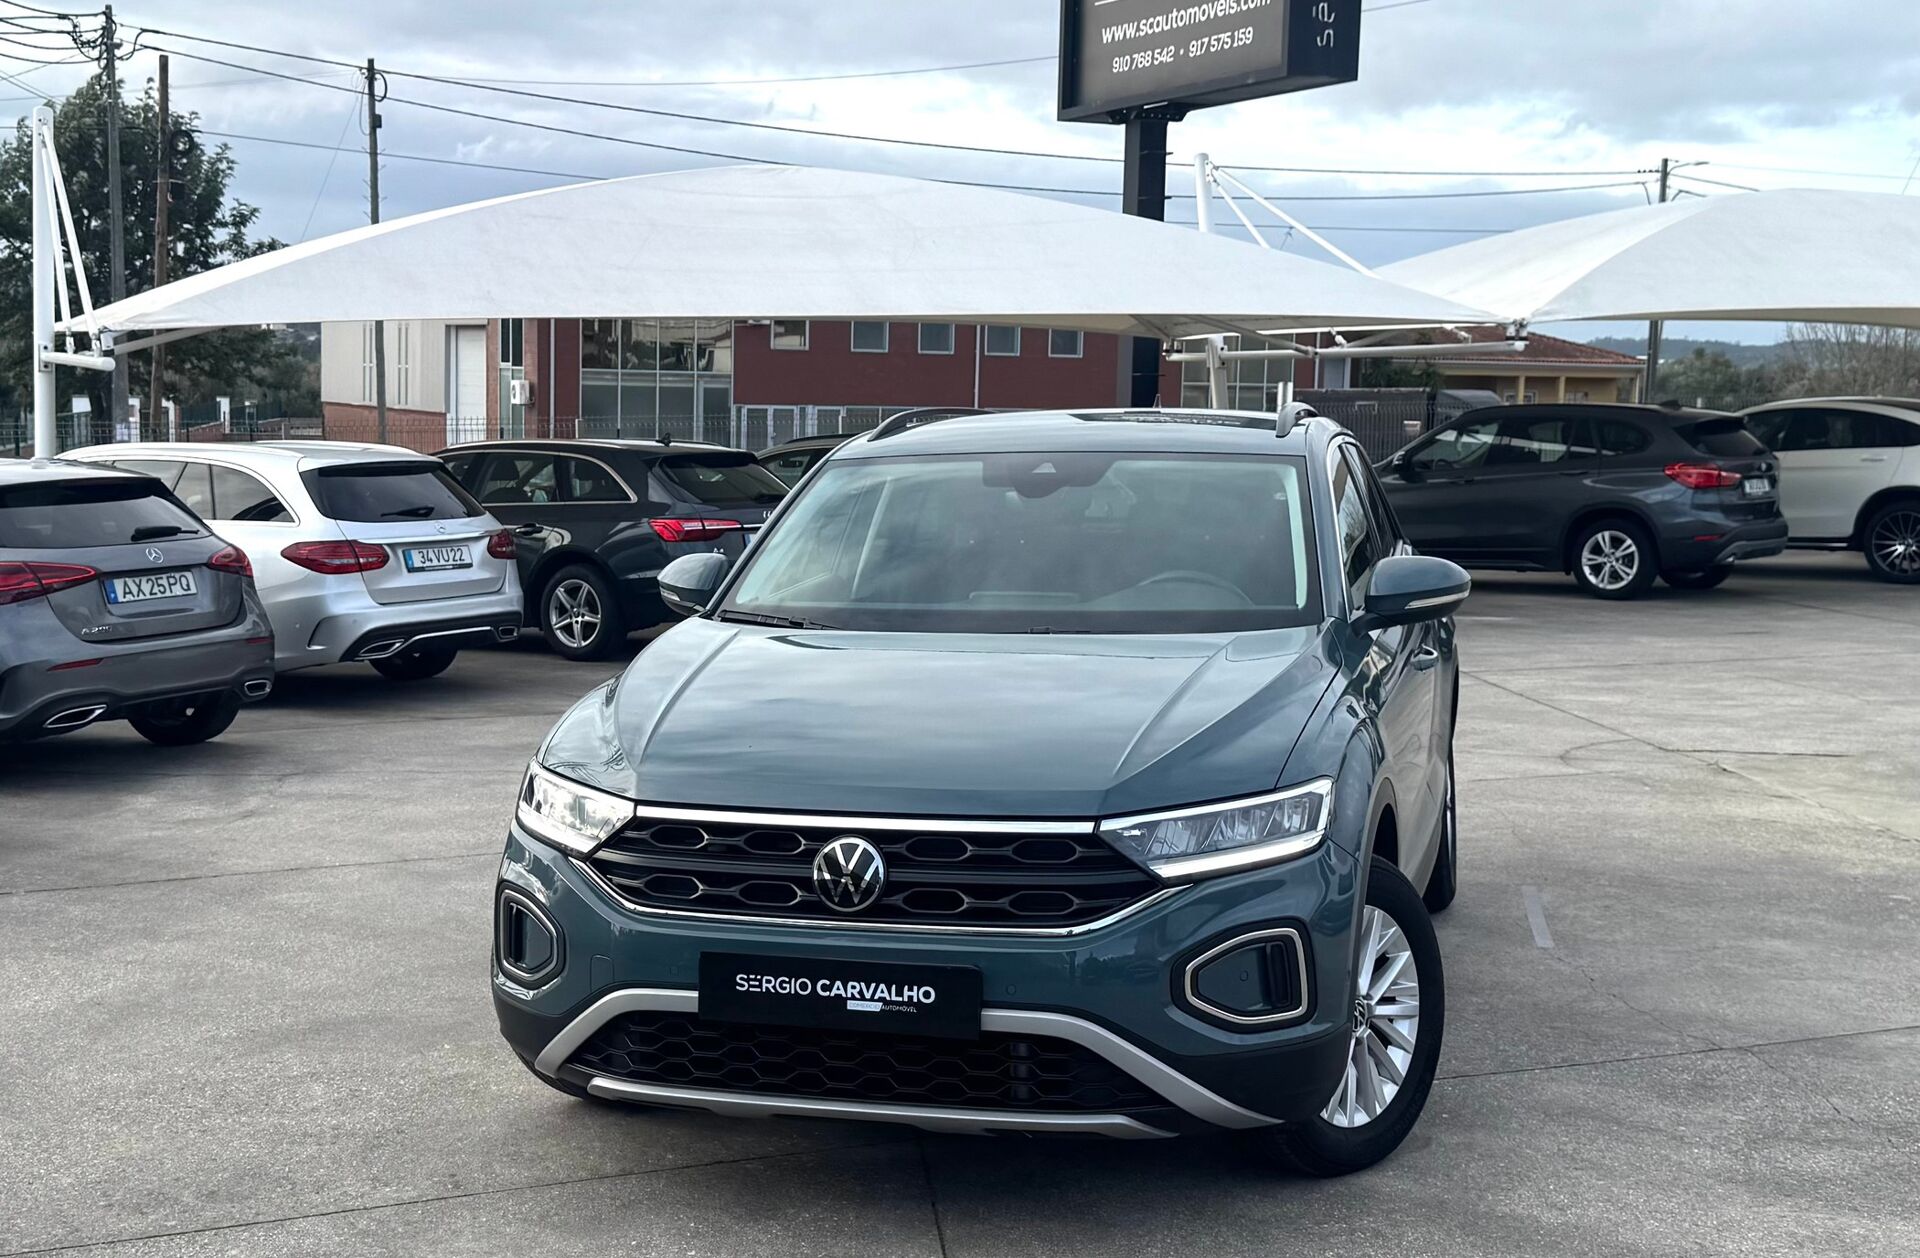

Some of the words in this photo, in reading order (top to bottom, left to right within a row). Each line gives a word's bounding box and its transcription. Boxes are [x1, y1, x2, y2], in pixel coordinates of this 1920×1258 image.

[1112, 54, 1131, 73] 910
[1131, 51, 1152, 70] 768
[1153, 45, 1174, 65] 542
[1188, 36, 1209, 57] 917
[1209, 31, 1232, 52] 575
[1232, 26, 1254, 47] 159
[816, 979, 936, 1004] CARVALHO
